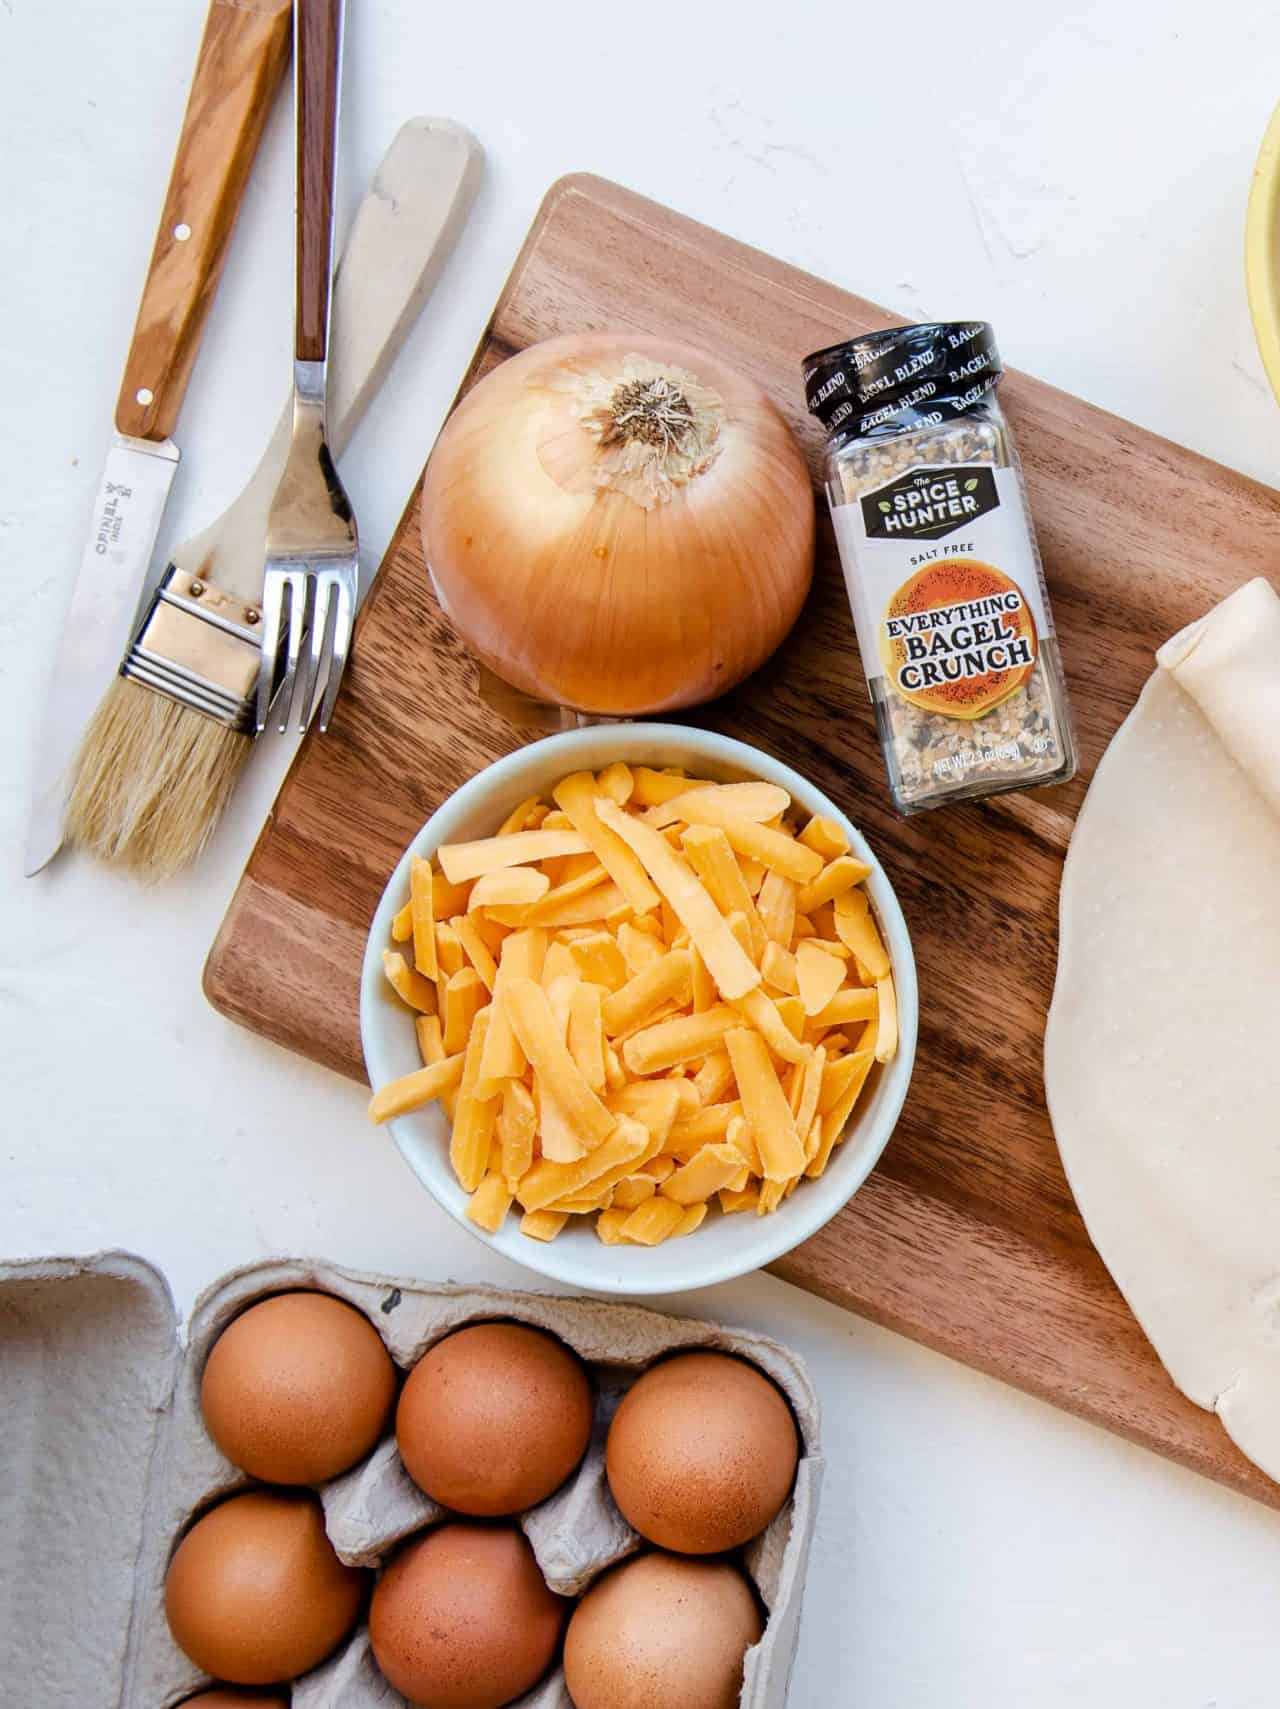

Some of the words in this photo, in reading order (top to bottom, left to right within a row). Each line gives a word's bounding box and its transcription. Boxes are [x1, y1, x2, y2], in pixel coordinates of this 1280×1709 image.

[817, 371, 845, 402] BLEND
[858, 376, 896, 404] BAGEL
[894, 346, 935, 381] BLEND
[948, 353, 987, 383] BAGEL
[860, 404, 899, 432] BAGEL
[898, 382, 937, 410] BLEND
[952, 384, 984, 411] BAGEL
[893, 479, 961, 511] SPICE
[96, 498, 118, 555] OPINEL
[910, 550, 938, 566] SALT
[943, 543, 974, 555] FREE
[886, 593, 1021, 637] EVERYTHING
[906, 618, 1013, 661] BAGEL
[899, 639, 1032, 689] CRUNCH
